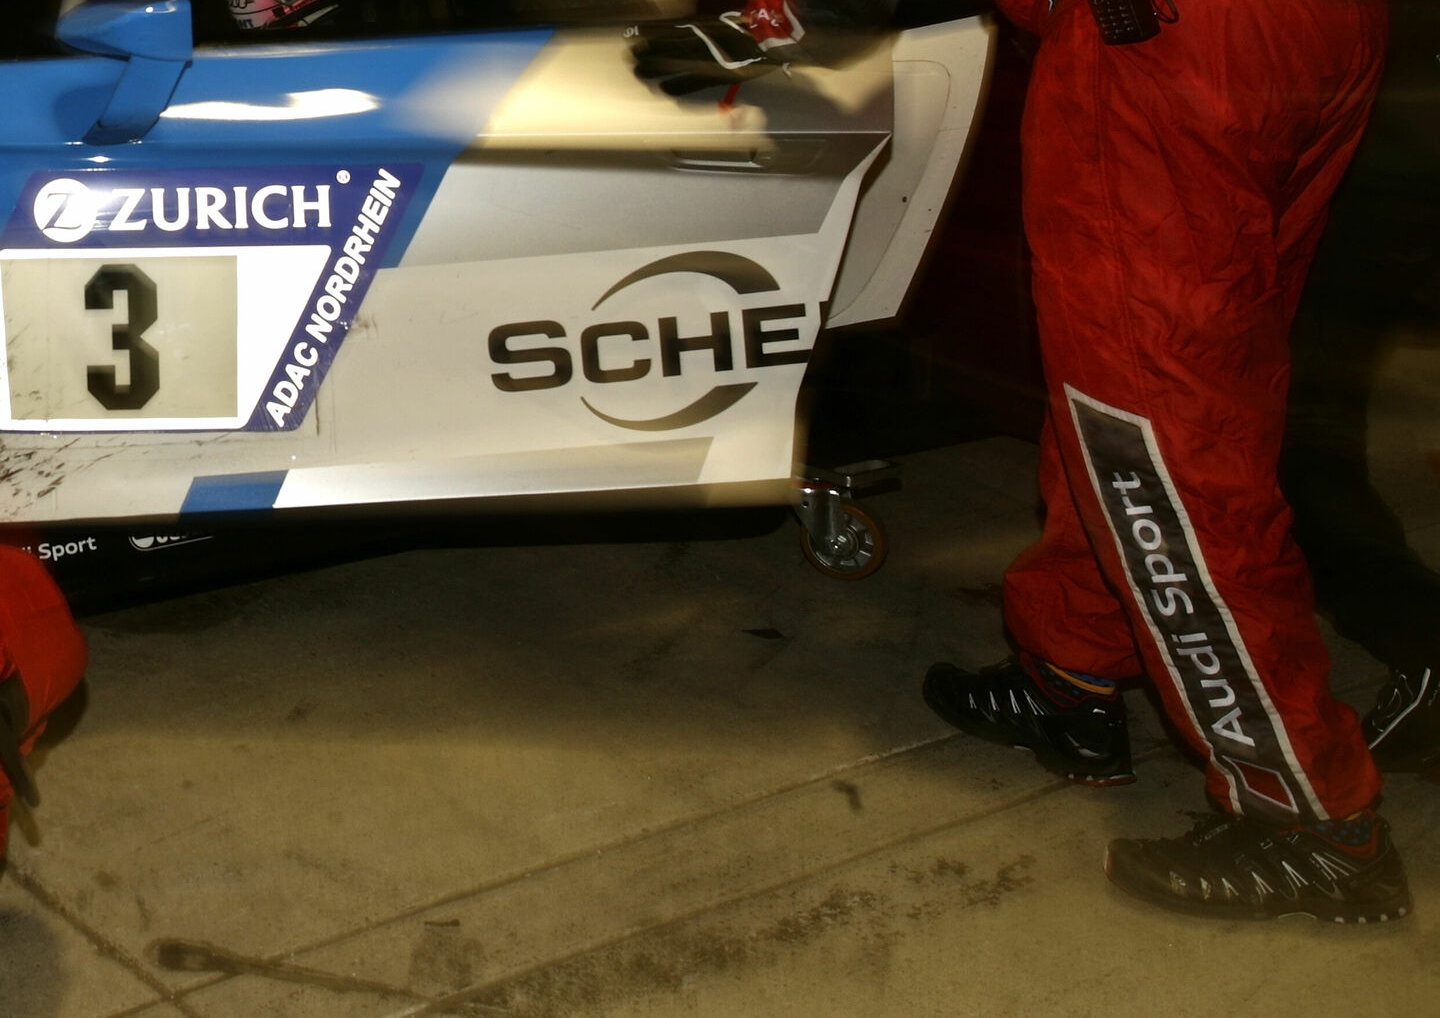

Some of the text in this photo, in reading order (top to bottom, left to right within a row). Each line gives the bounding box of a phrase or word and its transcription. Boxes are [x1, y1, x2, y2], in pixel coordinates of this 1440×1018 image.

[107, 184, 332, 231] ZURICH
[84, 264, 160, 410] 3
[265, 168, 402, 427] ADAC NORDRHEIN
[488, 300, 828, 393] SCHE
[39, 536, 98, 562] Sport
[1113, 471, 1195, 618] Sport
[1173, 632, 1257, 747] Audi
